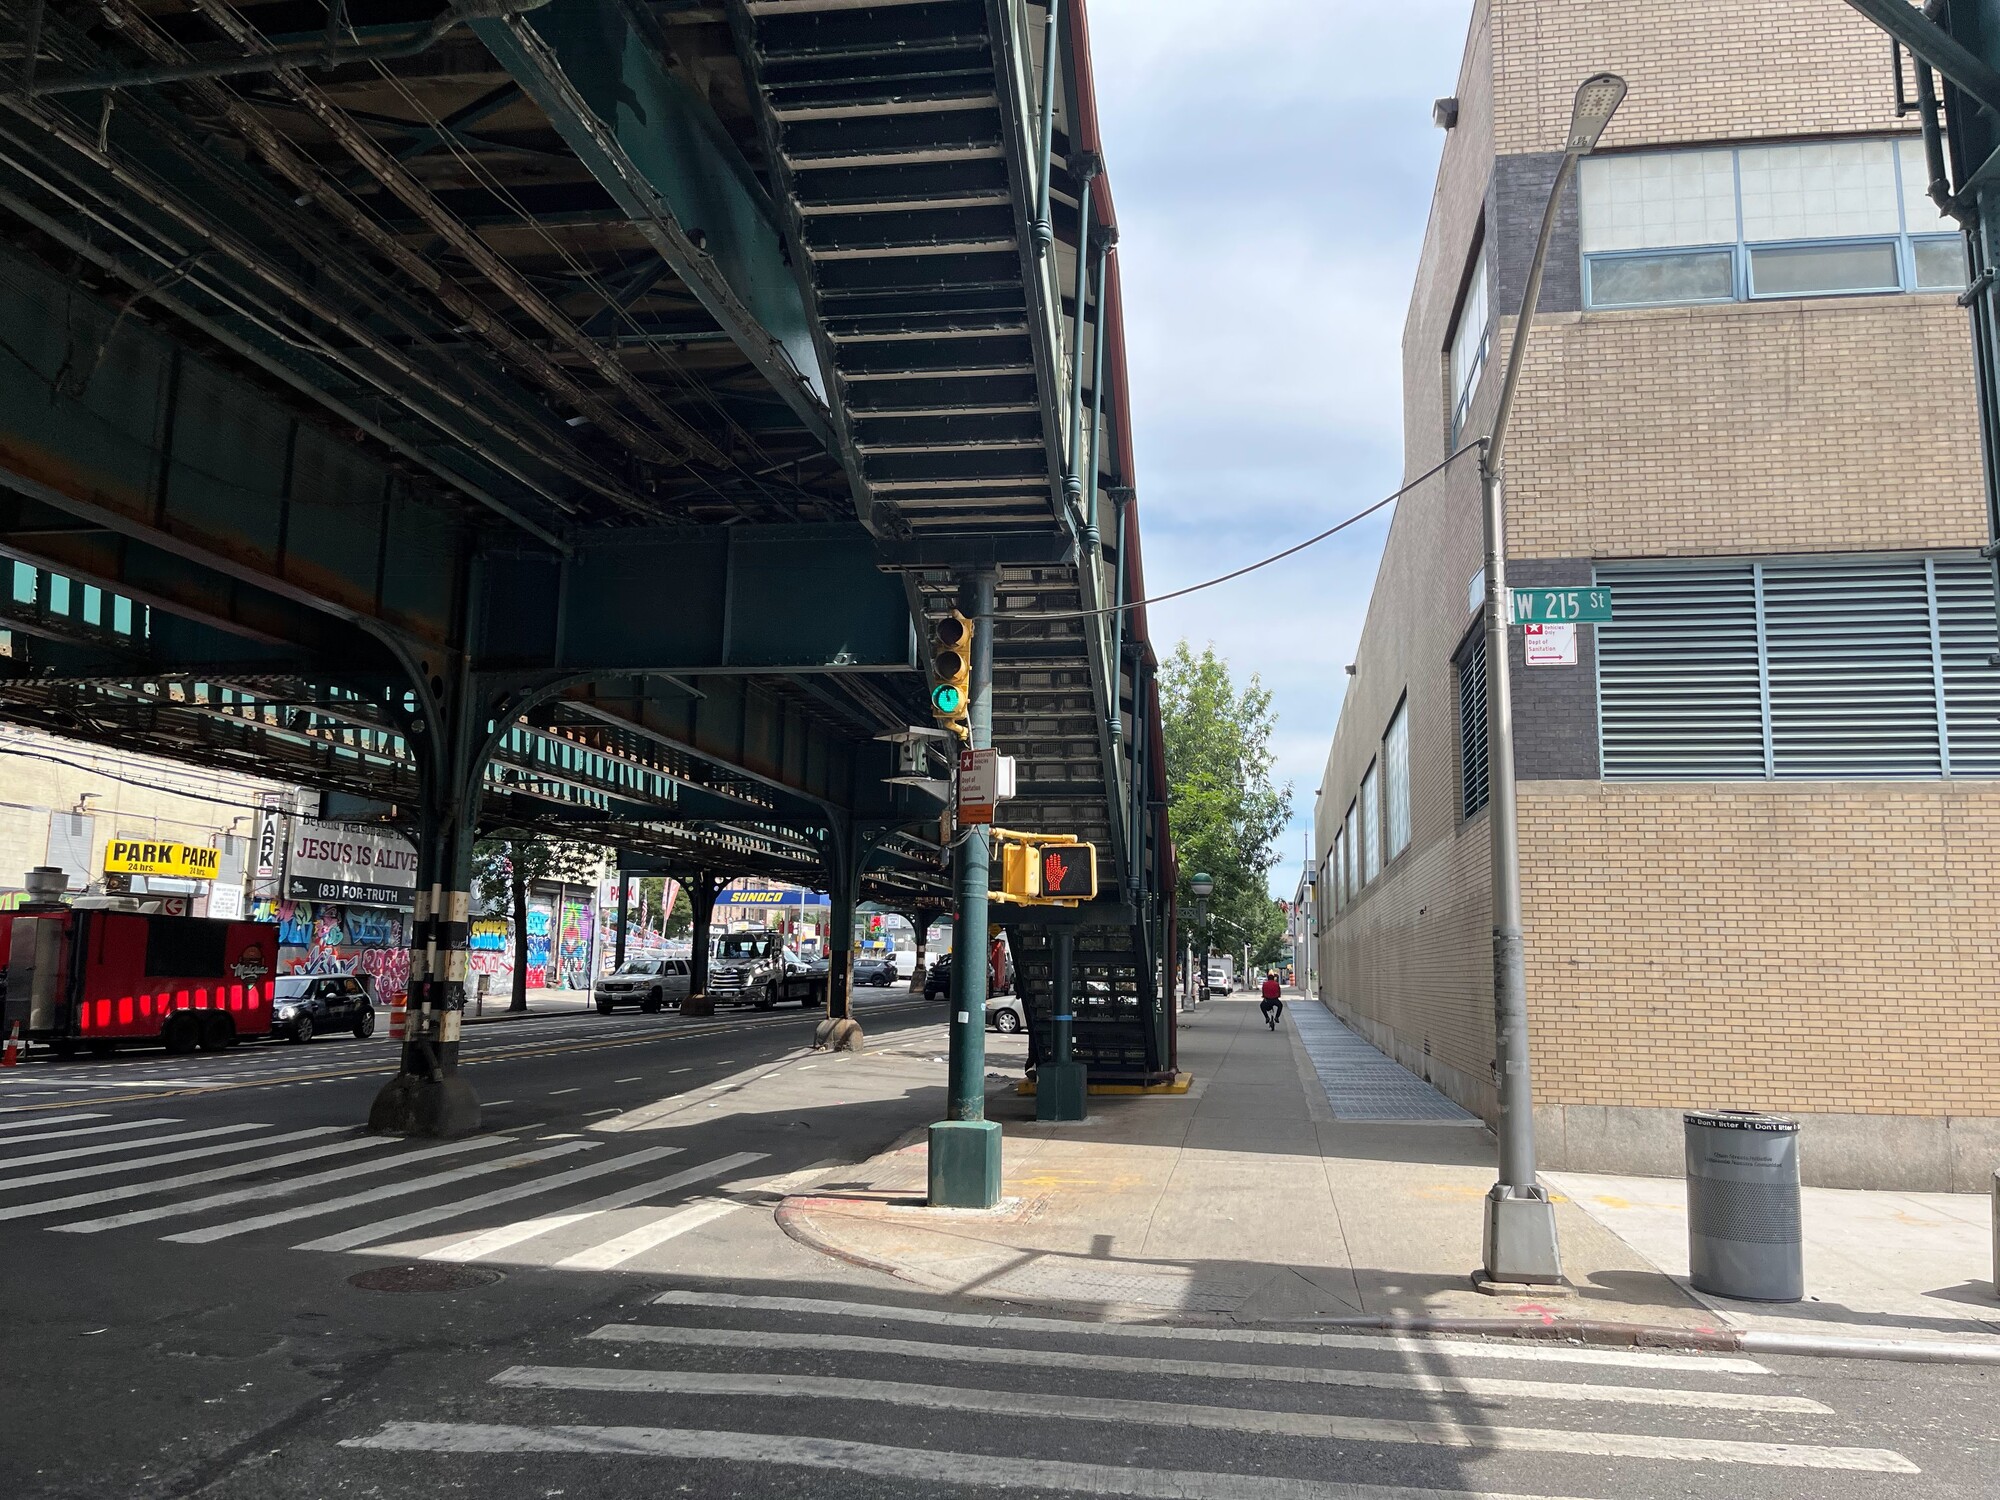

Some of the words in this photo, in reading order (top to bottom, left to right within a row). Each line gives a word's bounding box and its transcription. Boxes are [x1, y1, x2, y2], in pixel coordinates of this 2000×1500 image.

[1516, 593, 1533, 619] W
[1545, 592, 1580, 619] 215
[1590, 592, 1604, 609] St
[259, 805, 278, 866] PARK
[113, 842, 173, 863] PARK
[181, 846, 217, 868] PARK
[297, 837, 353, 864] JESUS
[356, 845, 372, 866] IS
[374, 848, 418, 872] ALIVE
[128, 863, 138, 871] 24
[140, 863, 155, 872] hrs.
[318, 882, 340, 899] (83)
[342, 884, 398, 903] FOR-TRUTH
[610, 885, 634, 901] PAK
[731, 892, 784, 902] SUNOCO
[1697, 1118, 1716, 1127] Don't
[1755, 1123, 1776, 1131] Don't
